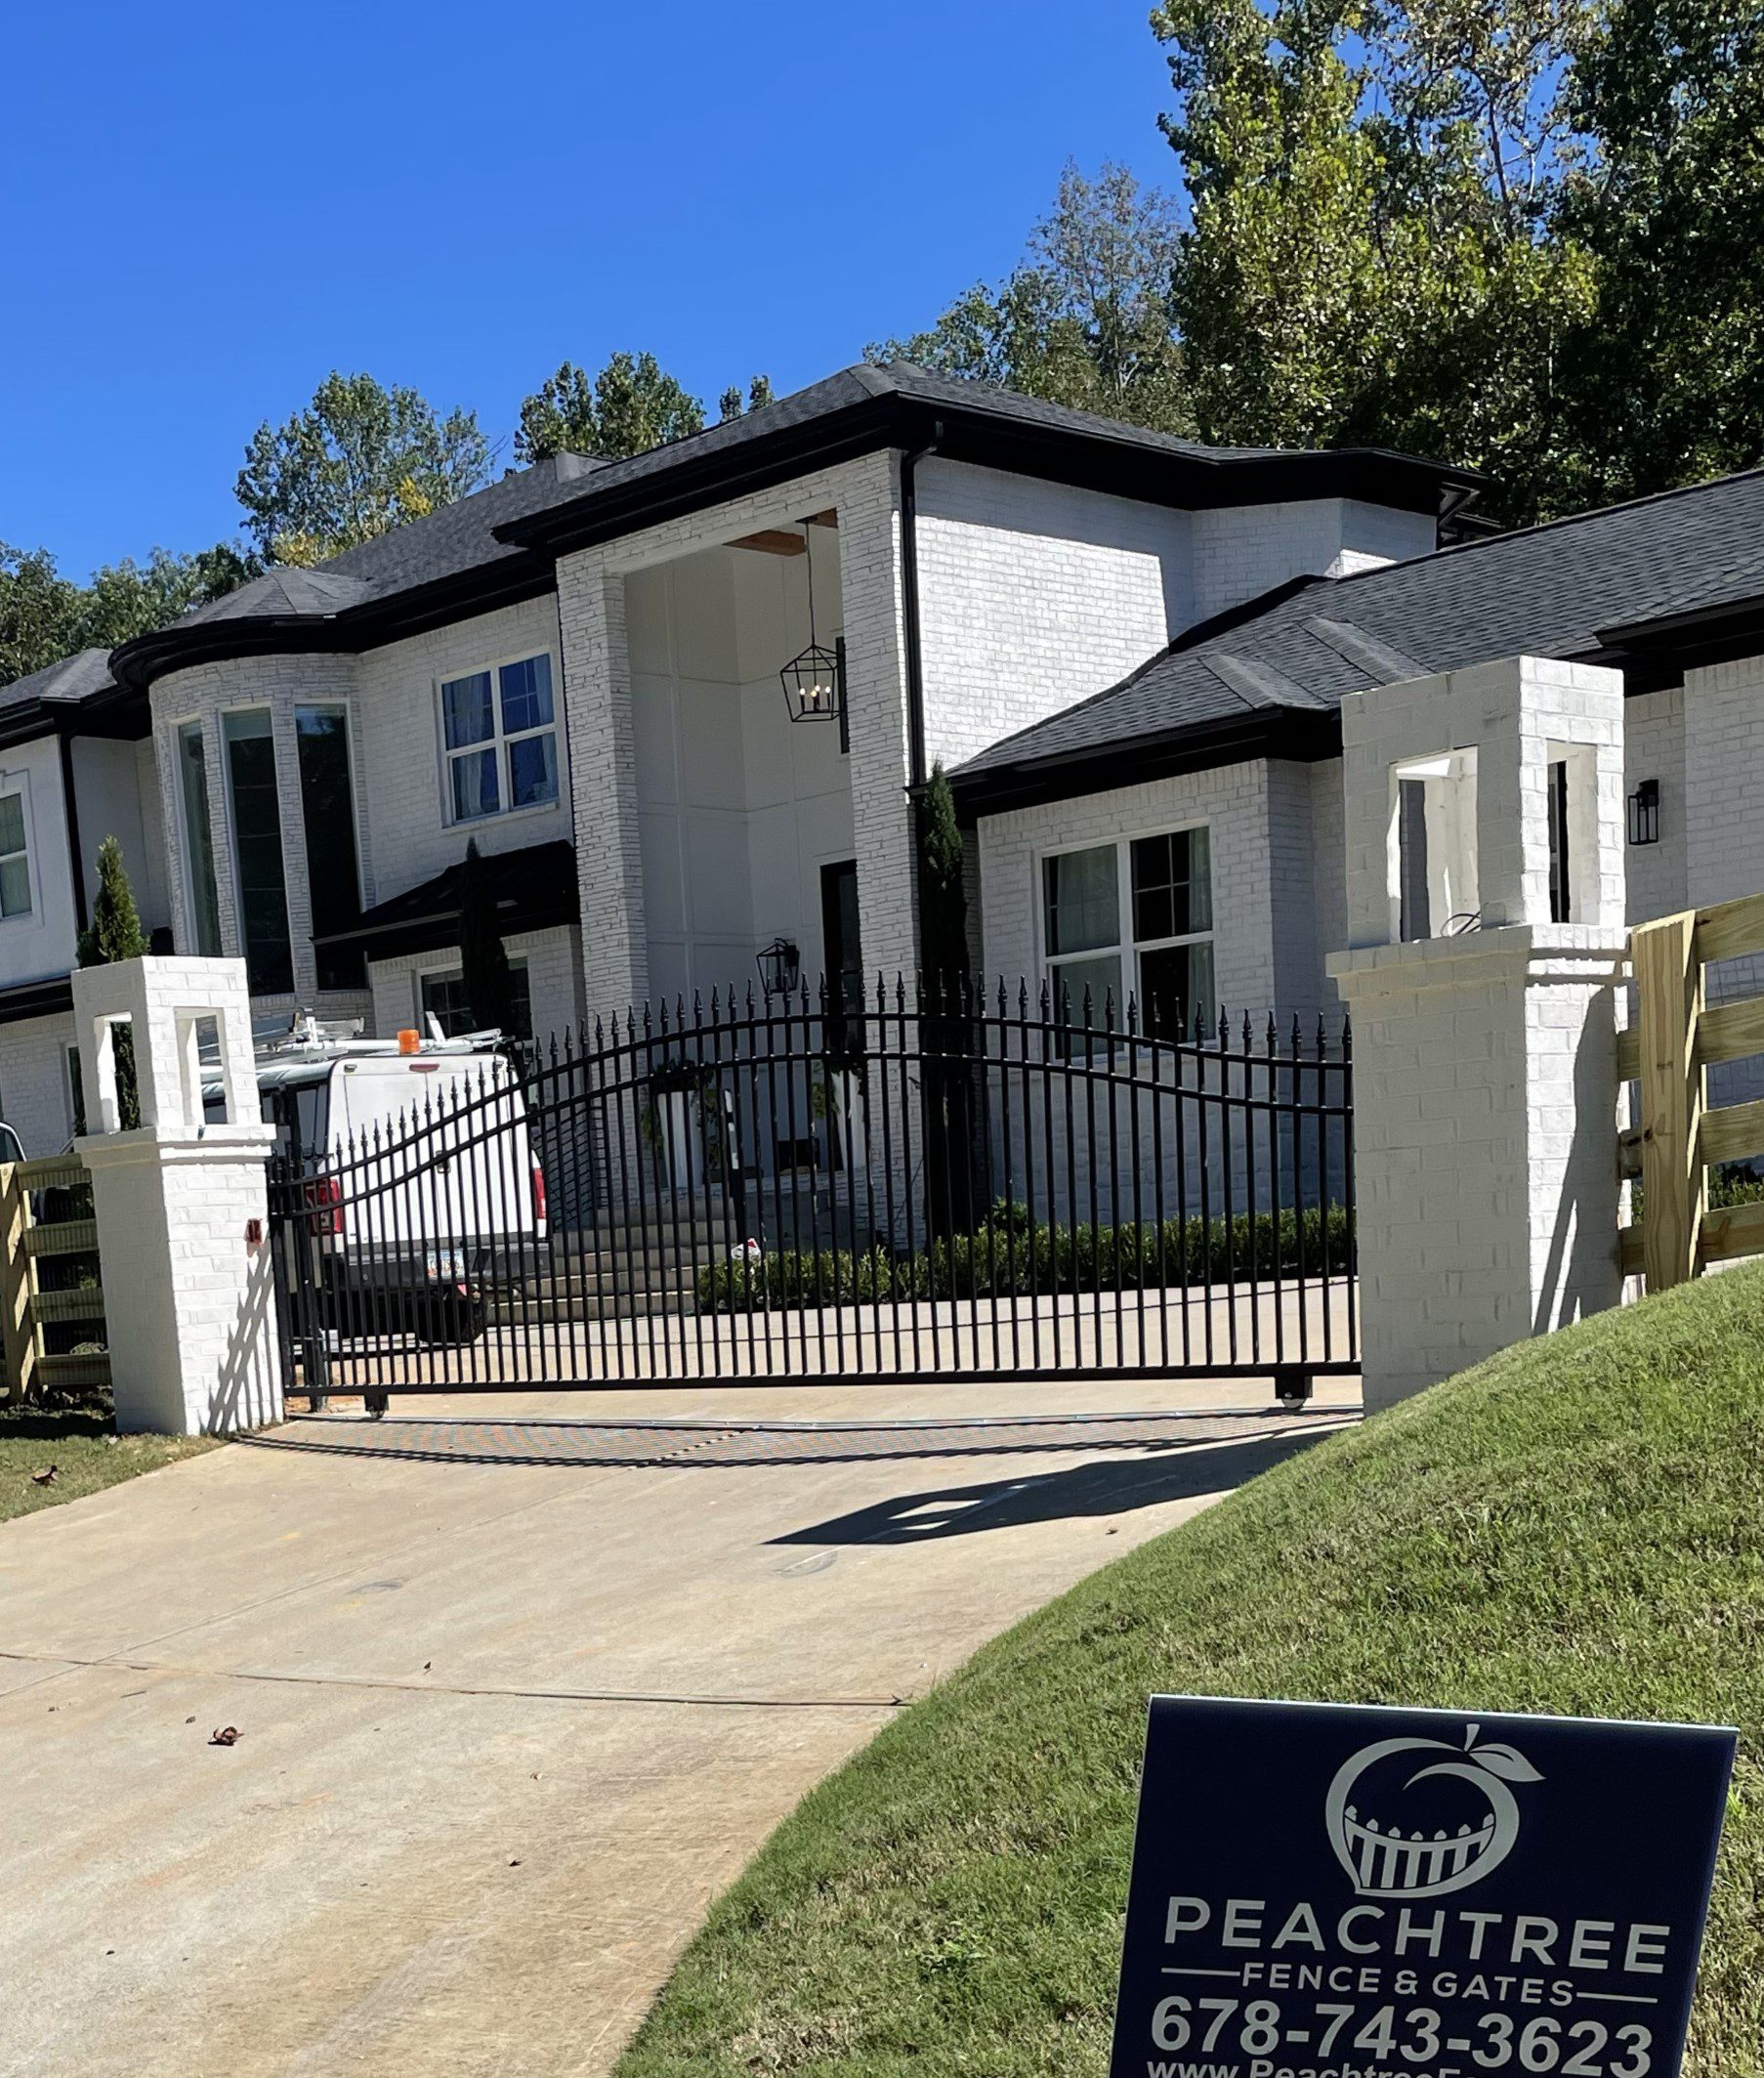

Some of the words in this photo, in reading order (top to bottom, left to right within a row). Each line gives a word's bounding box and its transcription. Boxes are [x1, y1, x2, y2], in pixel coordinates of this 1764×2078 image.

[1163, 1895, 1671, 1974] PEACHTREE
[1241, 1962, 1381, 1993] FENCE
[1394, 1970, 1418, 1995] &
[1432, 1972, 1575, 2007] GATES
[1151, 1995, 1654, 2078] 678-743-3623
